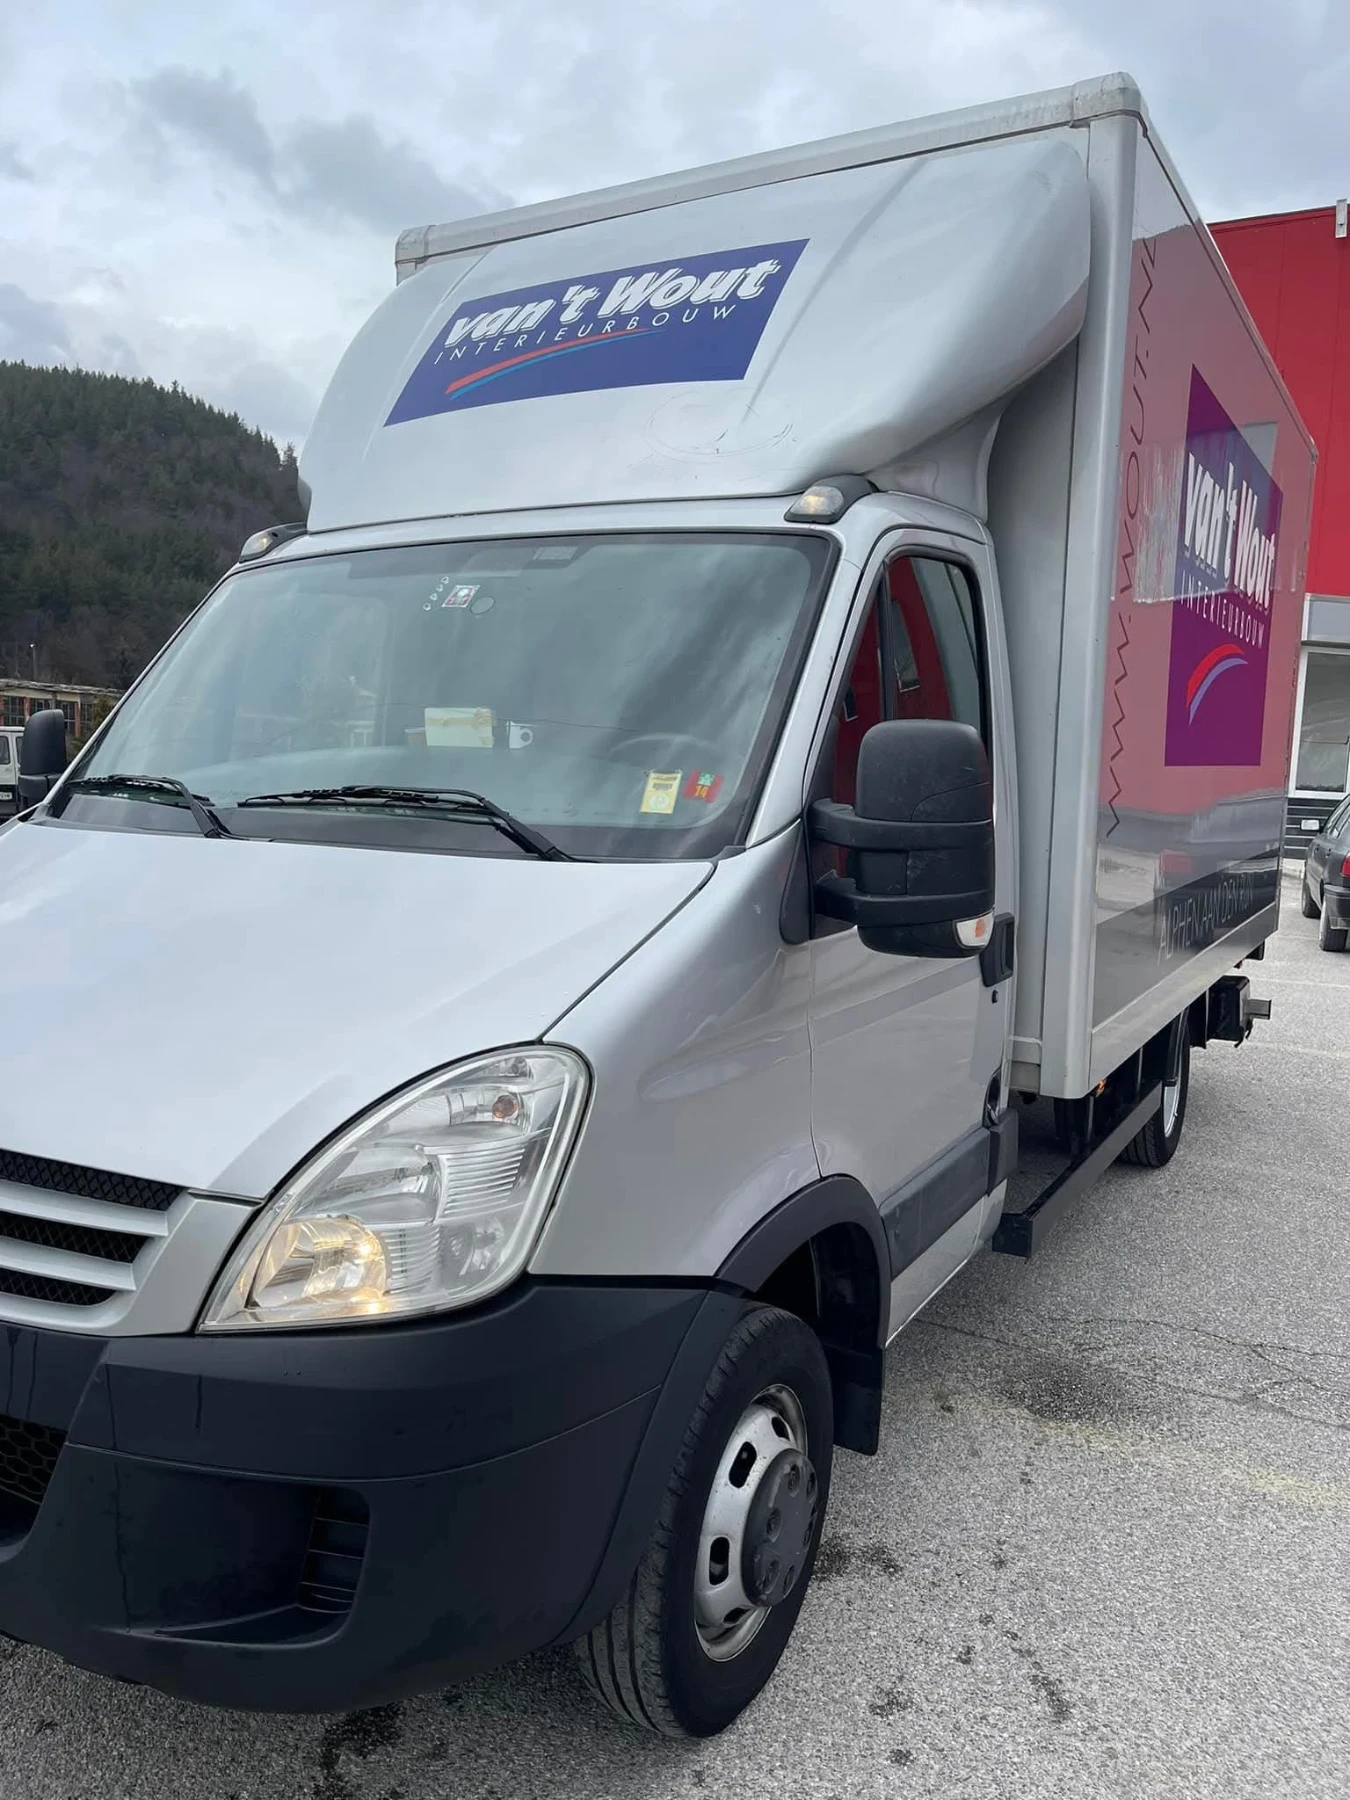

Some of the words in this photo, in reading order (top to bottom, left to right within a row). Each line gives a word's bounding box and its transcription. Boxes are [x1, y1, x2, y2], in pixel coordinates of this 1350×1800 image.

[597, 258, 782, 319] Wout
[434, 304, 736, 365] INTERIEURBOUW
[1233, 478, 1277, 615] Wout
[1180, 569, 1266, 649] INTERIEURBOUW
[1157, 892, 1201, 966] ALPHEN
